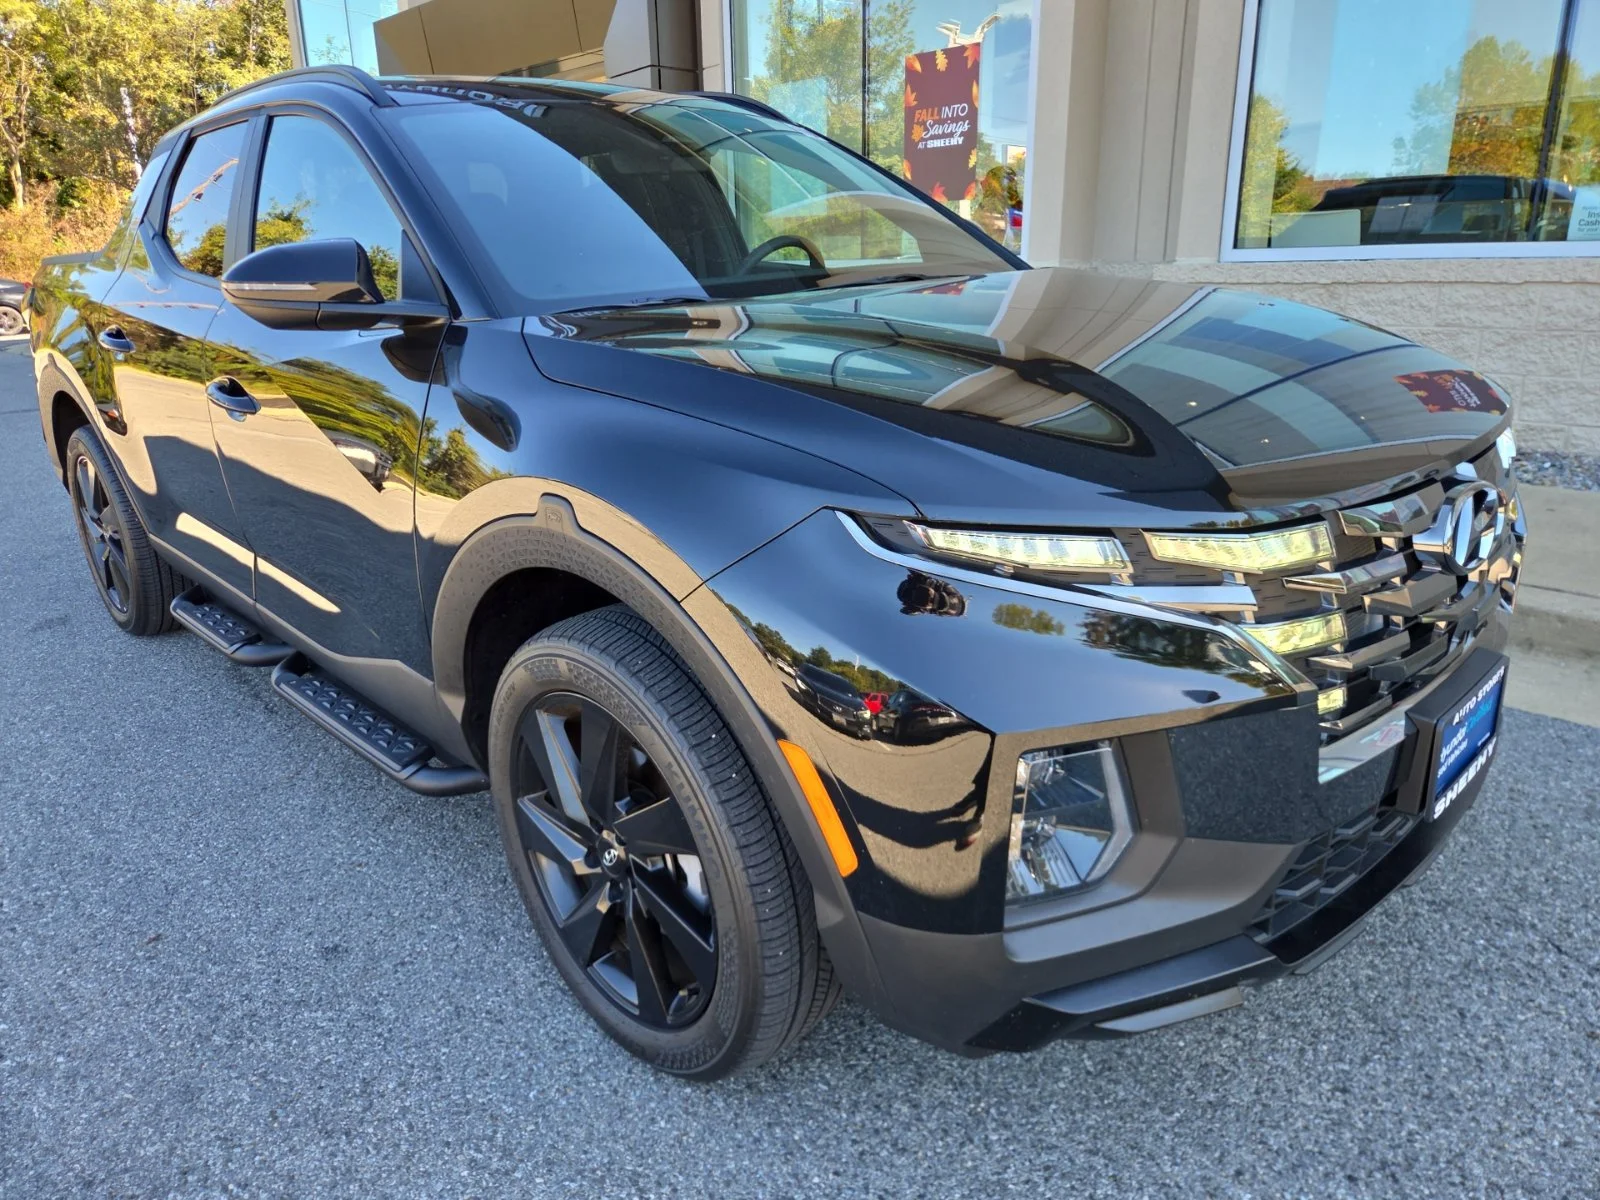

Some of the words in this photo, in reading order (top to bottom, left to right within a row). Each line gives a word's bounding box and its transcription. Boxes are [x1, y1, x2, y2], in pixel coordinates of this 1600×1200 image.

[914, 107, 939, 122] FALL
[941, 103, 968, 118] INTO
[922, 120, 971, 138] Savings
[917, 141, 926, 149] AT
[927, 136, 964, 148] SHEEHY
[1453, 696, 1476, 726] AUTO
[1433, 736, 1497, 820] SHEEHY
